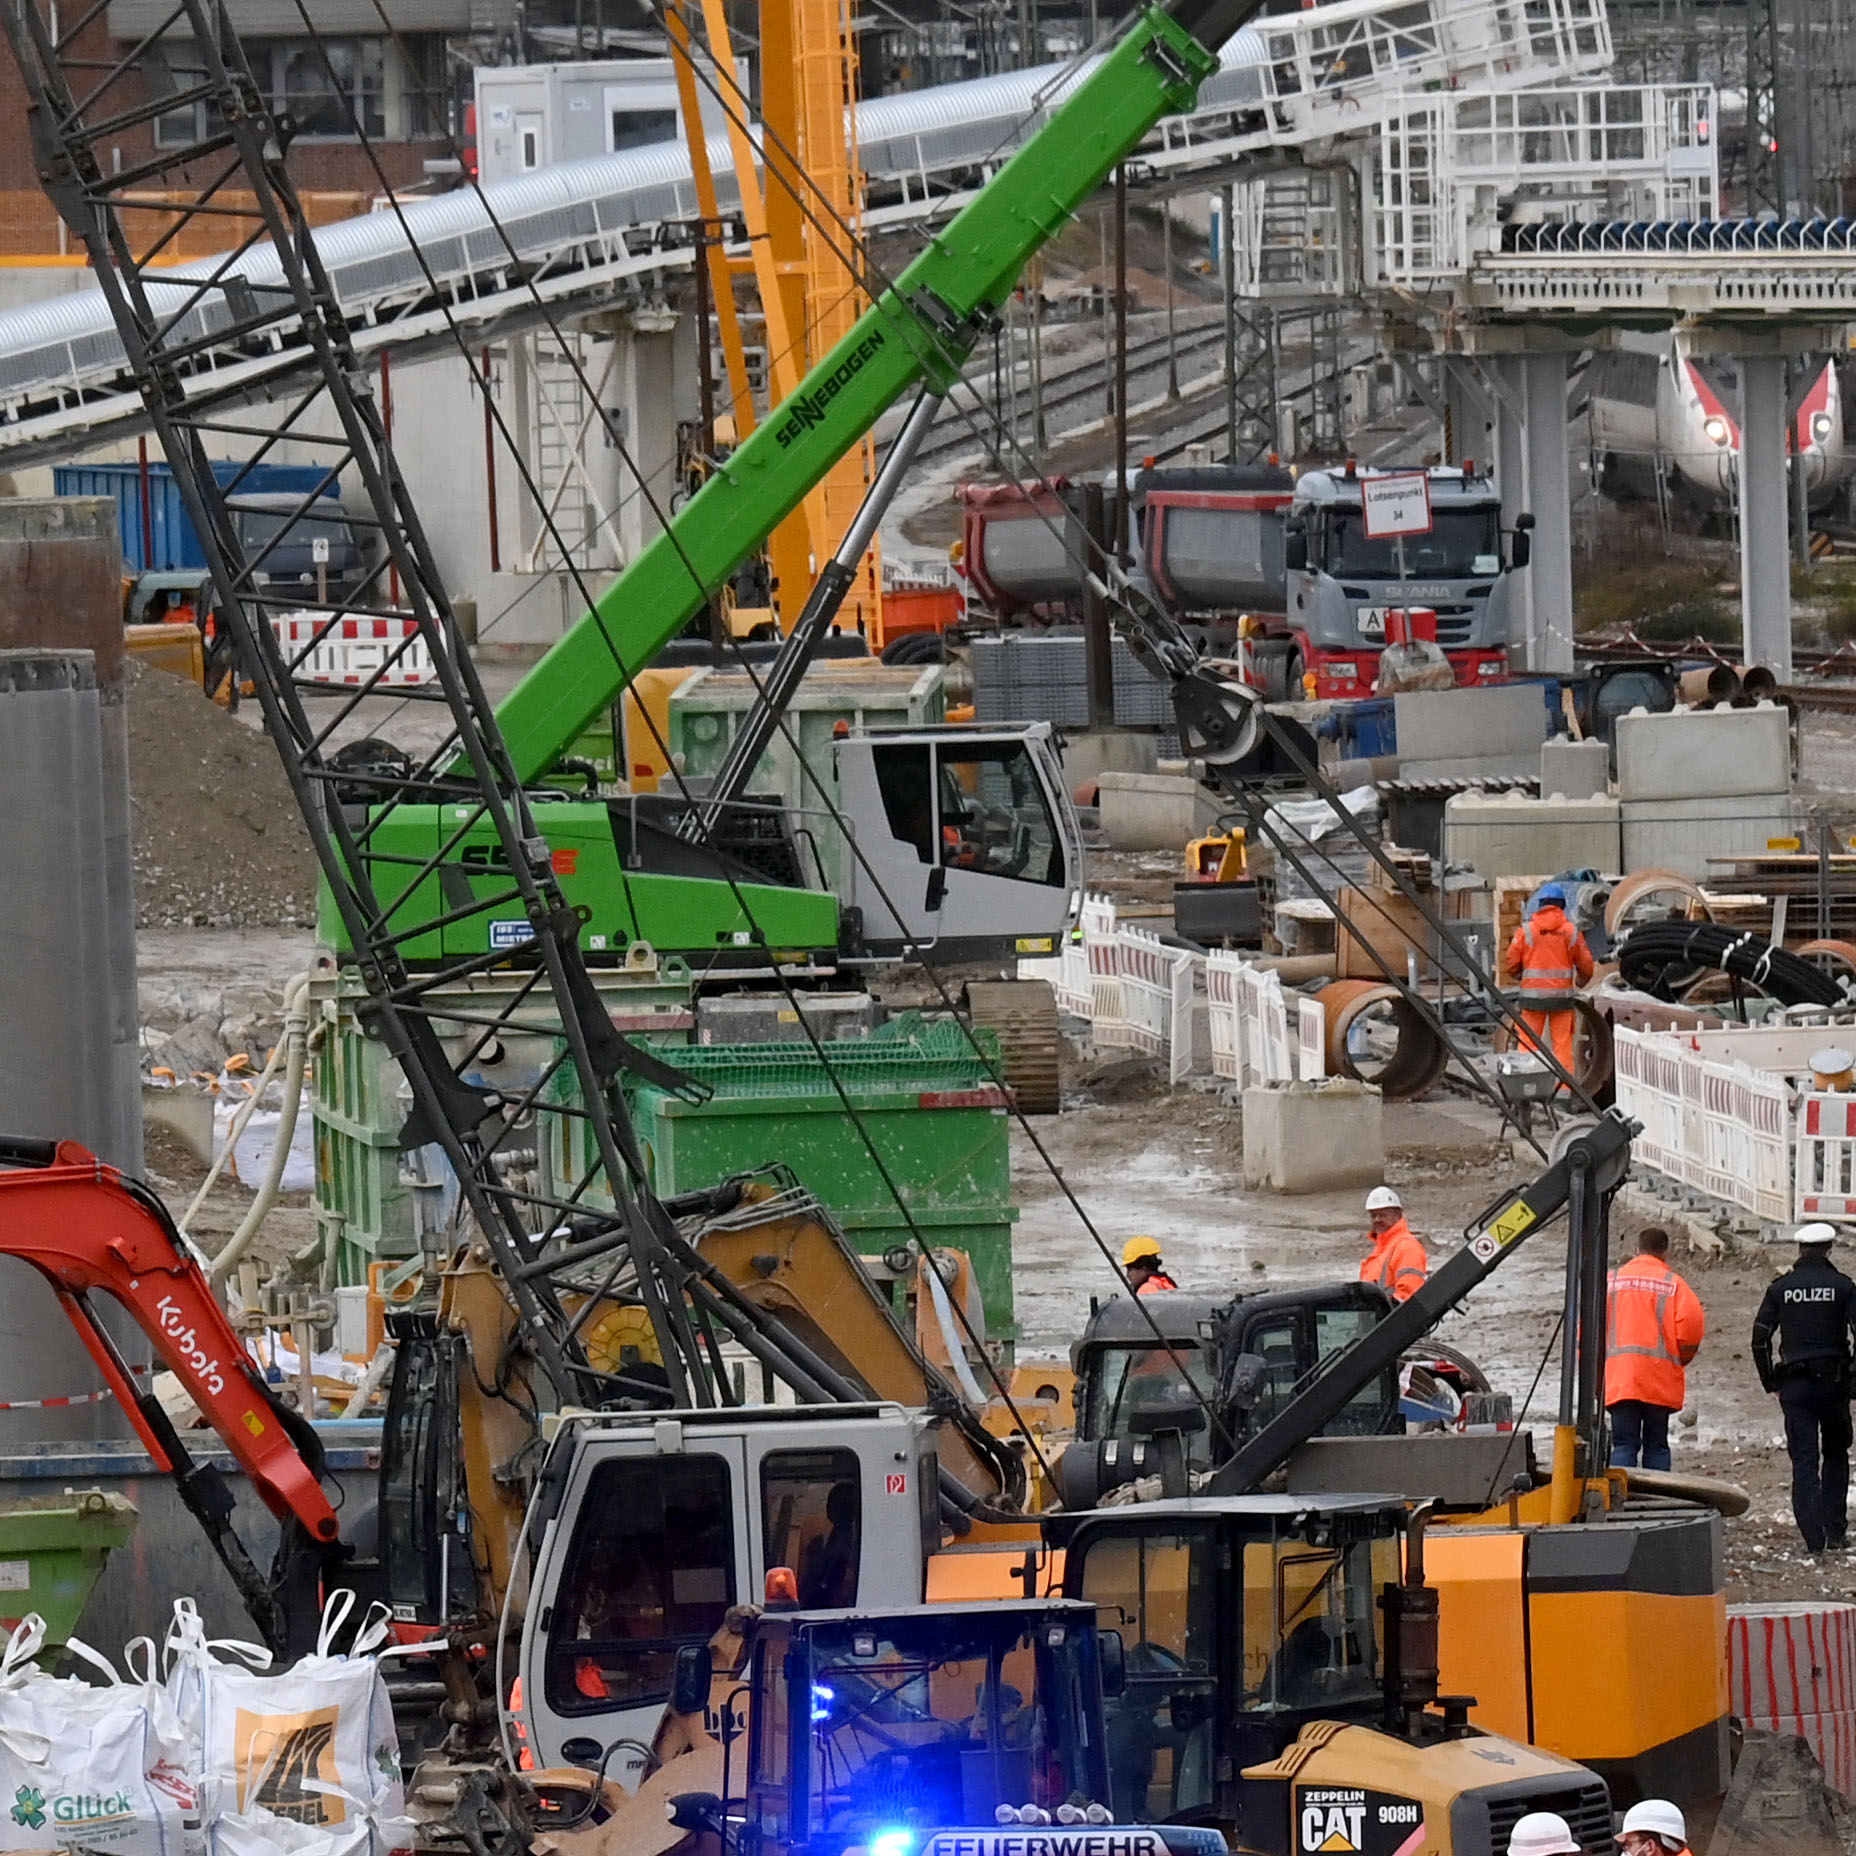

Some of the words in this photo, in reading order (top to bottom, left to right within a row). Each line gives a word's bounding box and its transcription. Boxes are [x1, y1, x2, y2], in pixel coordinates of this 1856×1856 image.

[775, 330, 885, 448] SENNEBOGEN
[1384, 587, 1451, 598] SCANIA
[1366, 611, 1381, 629] A
[1784, 1287, 1836, 1303] POLIZEI
[156, 1295, 226, 1396] Kubota
[53, 1790, 131, 1821] Glück
[1304, 1790, 1365, 1802] ZEPPELIN
[1301, 1806, 1367, 1852] CAT
[1378, 1805, 1418, 1823] 908H
